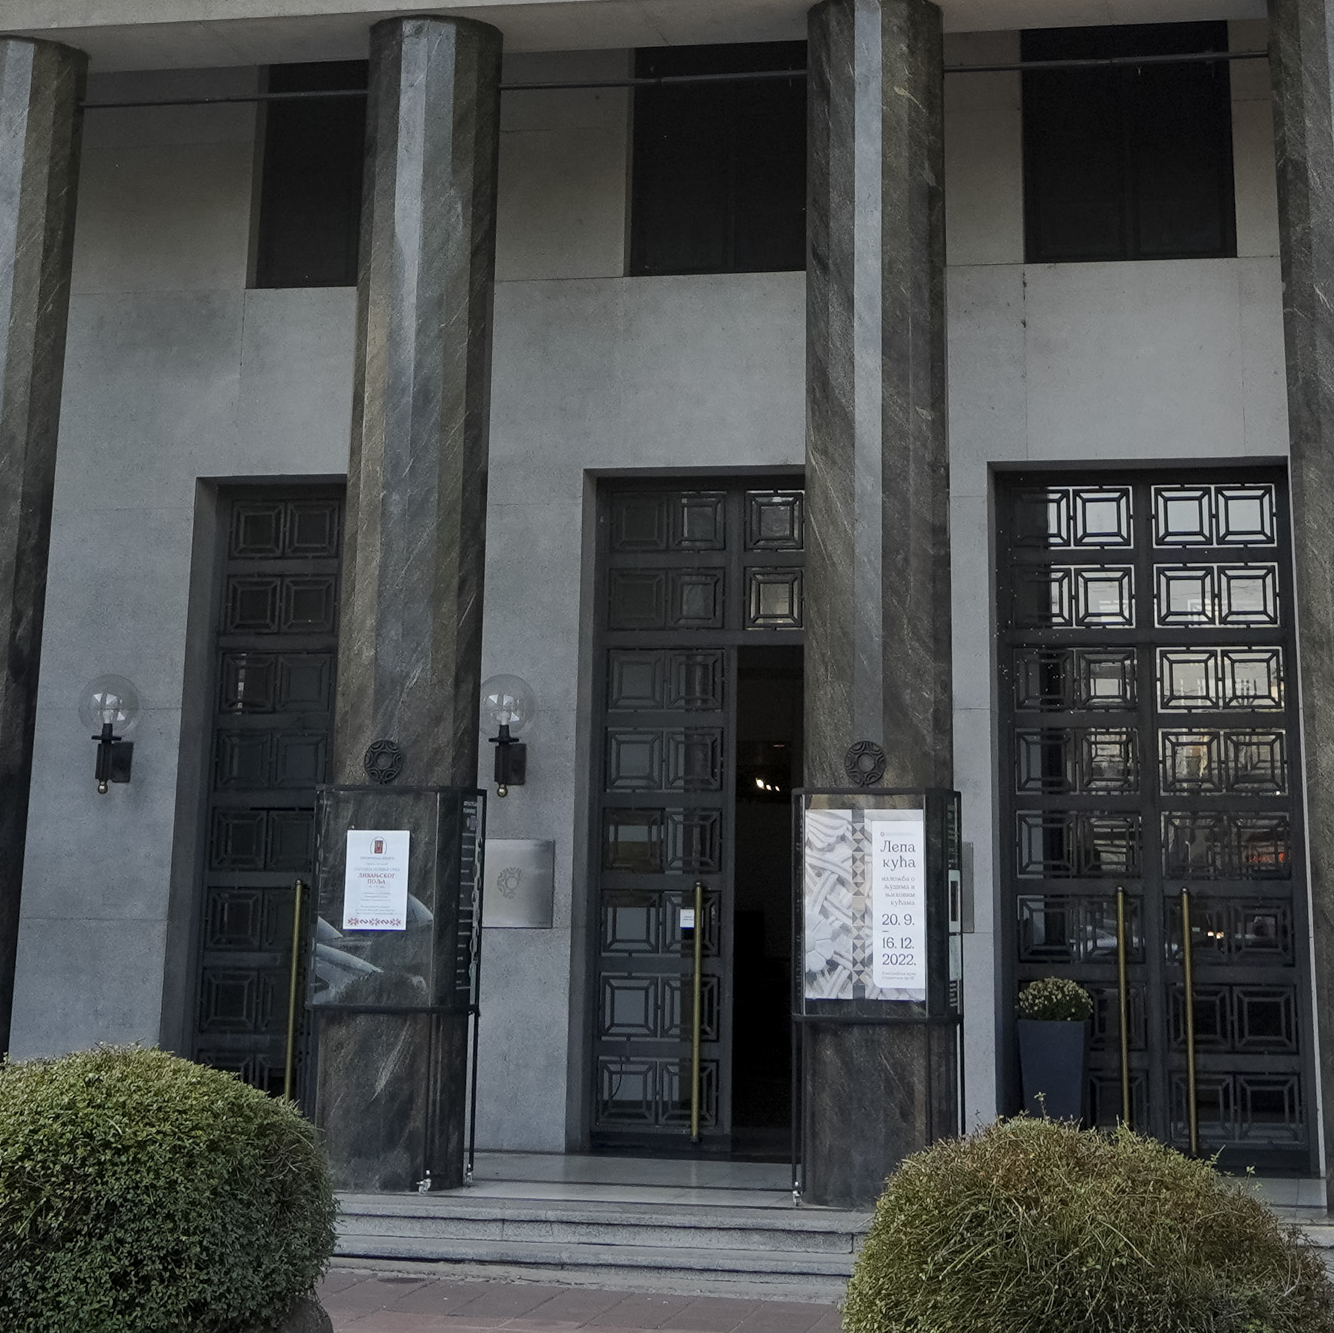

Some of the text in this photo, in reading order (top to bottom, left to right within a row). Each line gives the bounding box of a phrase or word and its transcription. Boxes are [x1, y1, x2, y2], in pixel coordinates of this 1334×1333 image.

[880, 839, 916, 853] Лепа
[882, 854, 916, 872] кућа
[881, 913, 915, 926] 20. 9.
[882, 936, 915, 950] 16. 12.
[882, 953, 917, 966] 2022.
